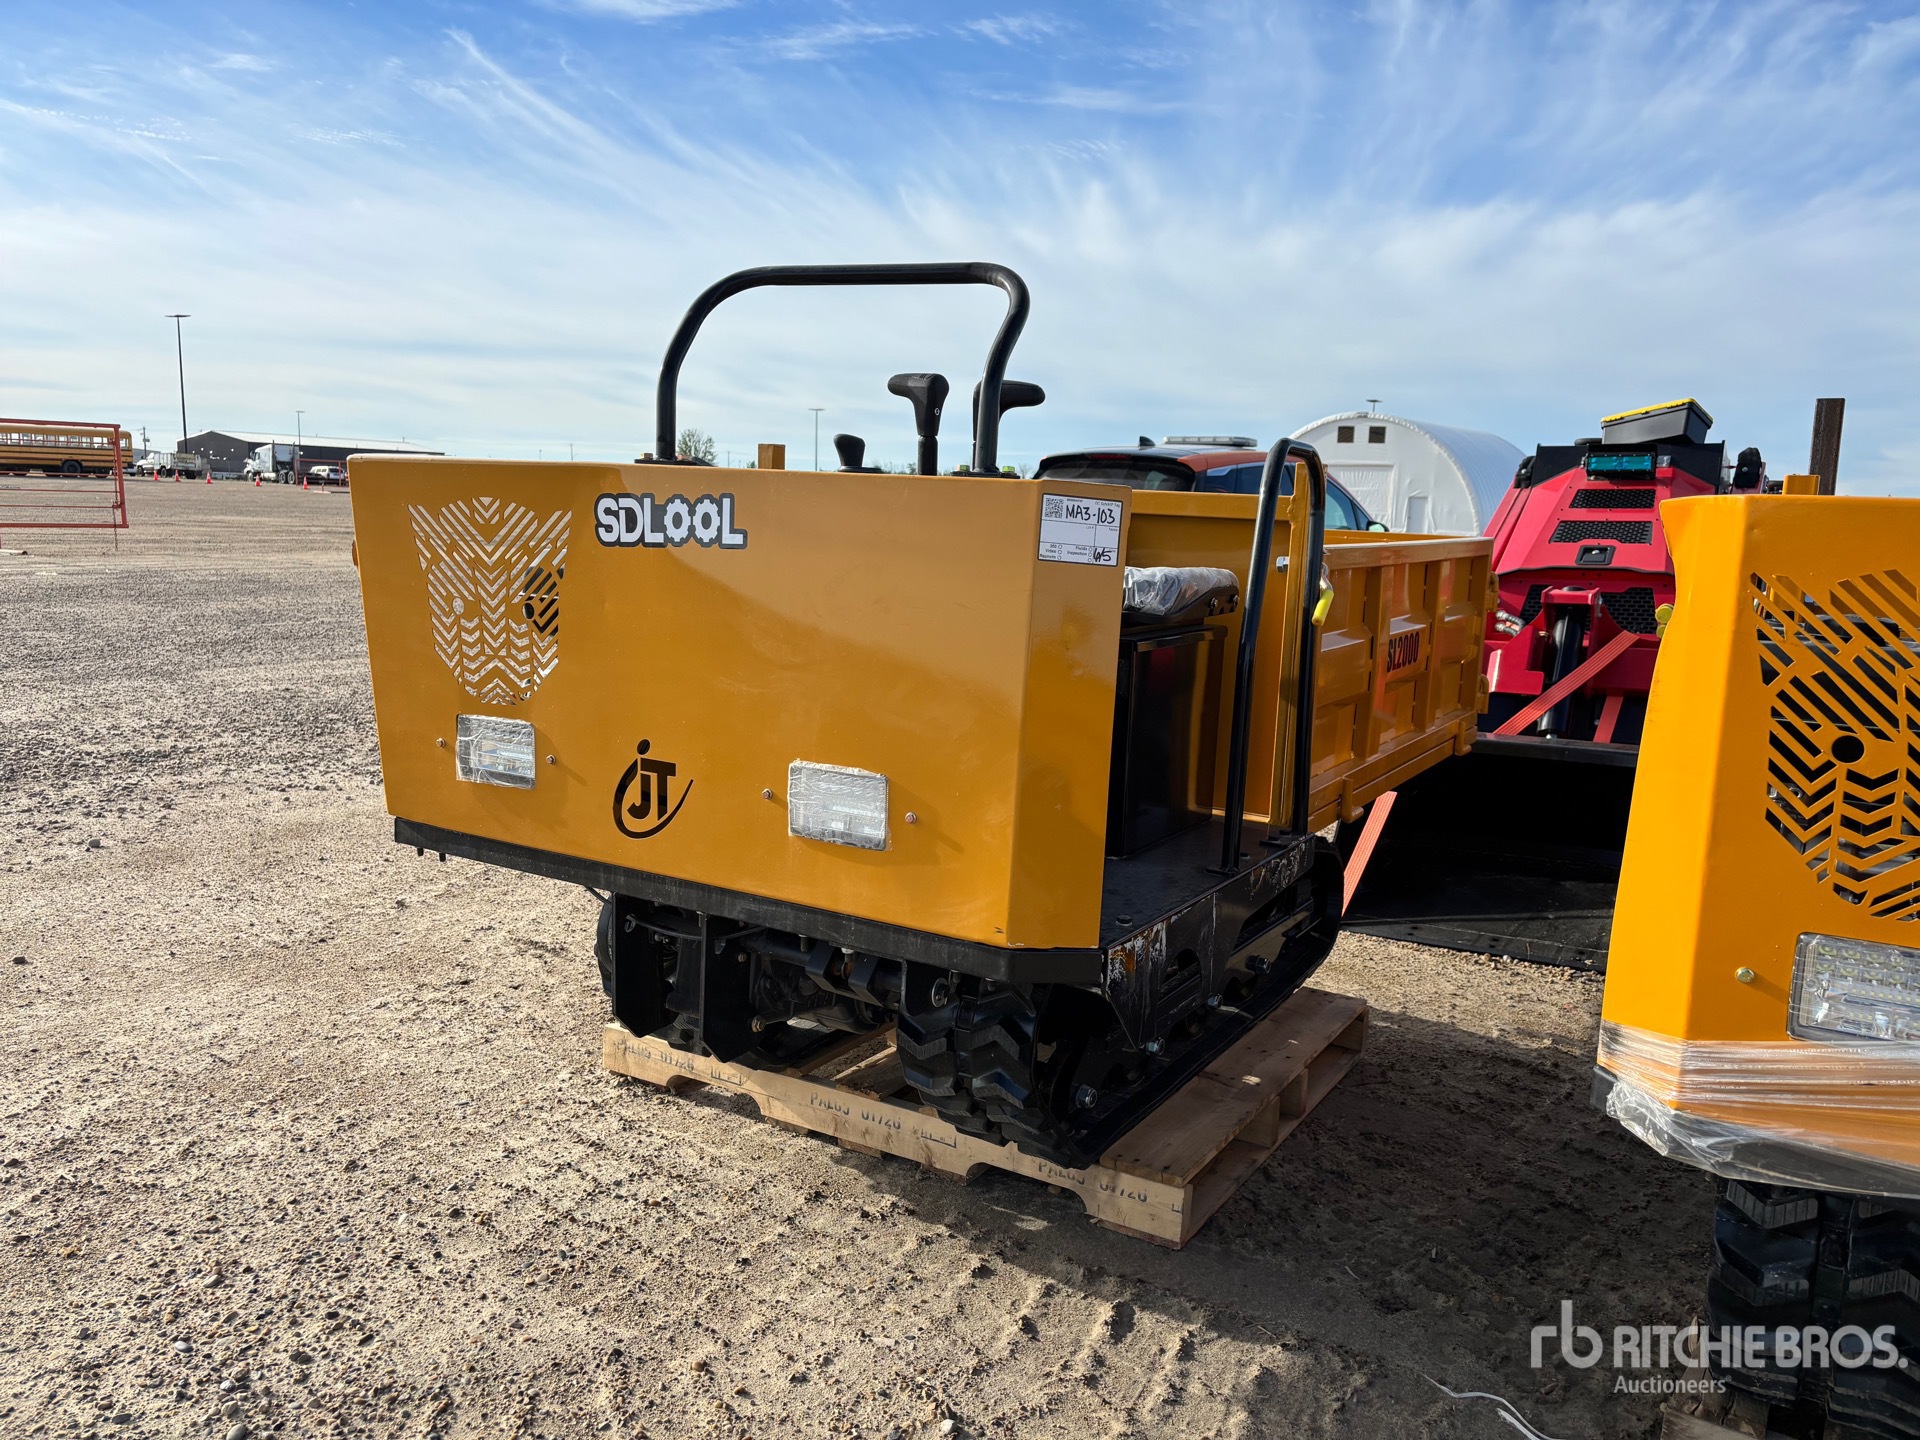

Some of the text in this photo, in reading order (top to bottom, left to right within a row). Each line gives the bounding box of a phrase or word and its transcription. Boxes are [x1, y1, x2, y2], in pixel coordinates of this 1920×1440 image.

[596, 495, 745, 547] SDLOOL
[1065, 504, 1116, 525] MA3-103
[1387, 631, 1420, 673] SL2000
